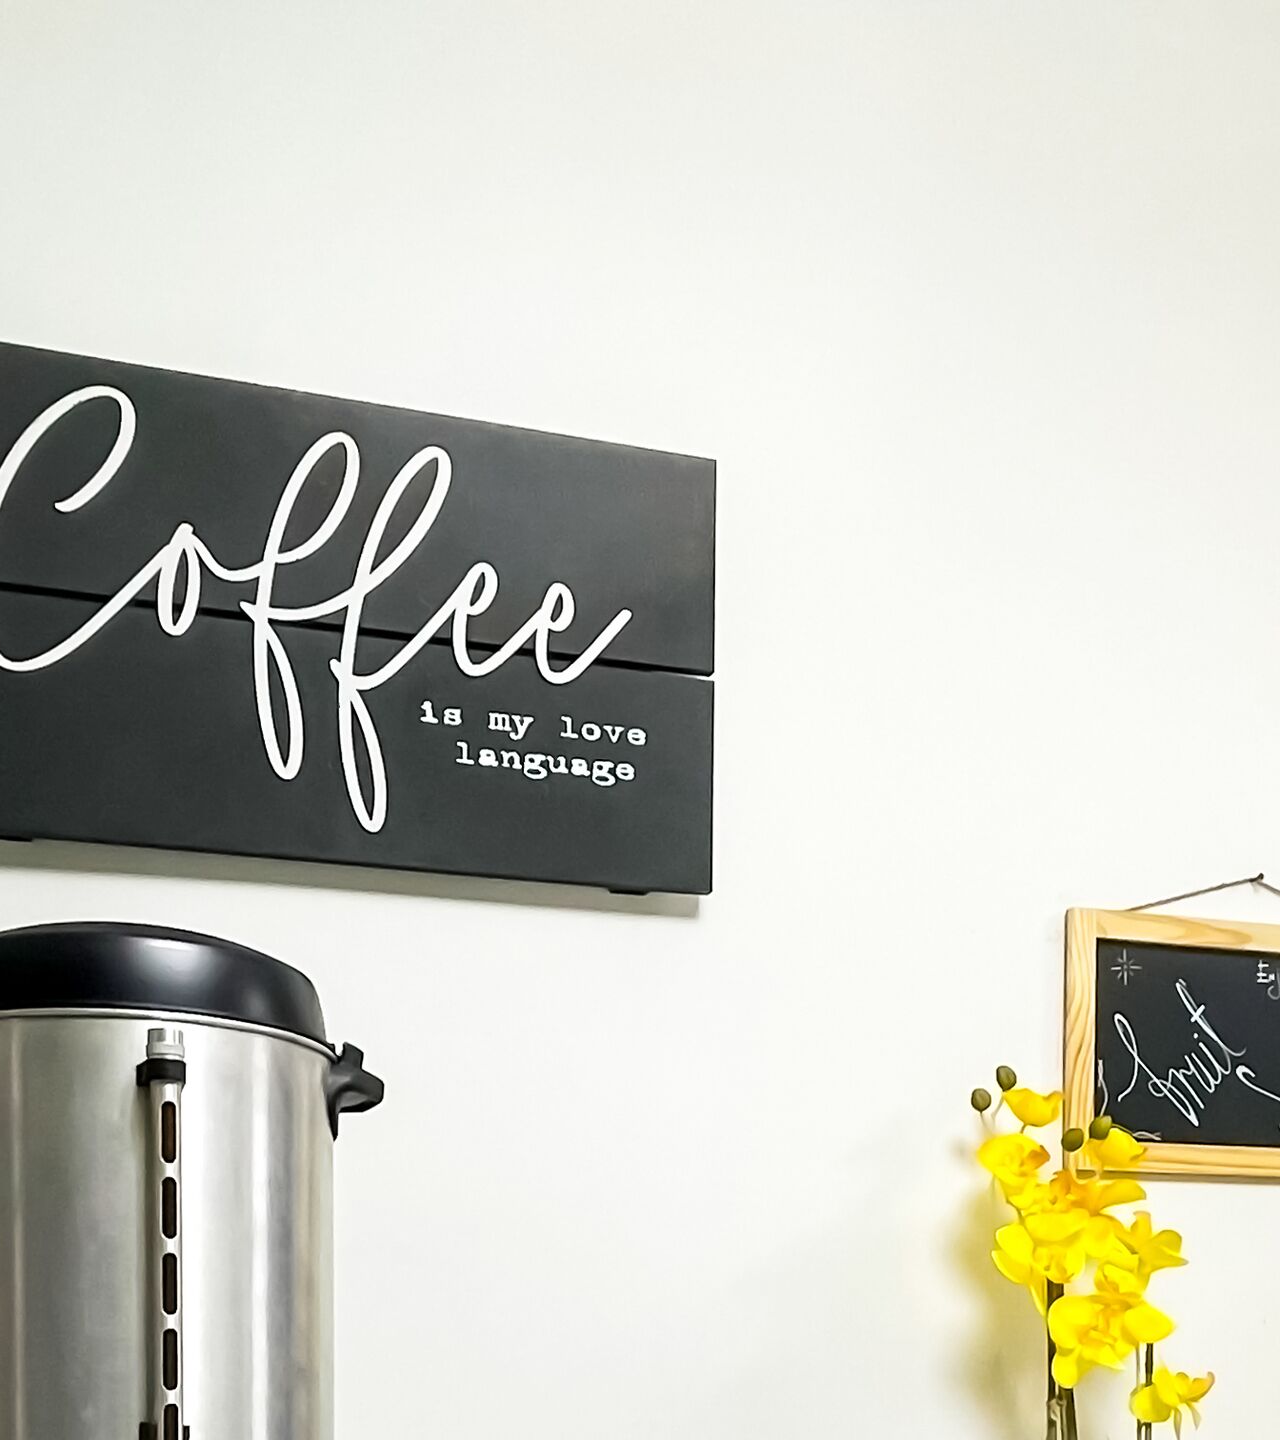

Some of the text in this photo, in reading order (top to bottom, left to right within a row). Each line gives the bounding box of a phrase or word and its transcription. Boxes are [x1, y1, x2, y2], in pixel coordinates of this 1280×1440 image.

[420, 701, 647, 746] is my love
[455, 741, 635, 787] language
